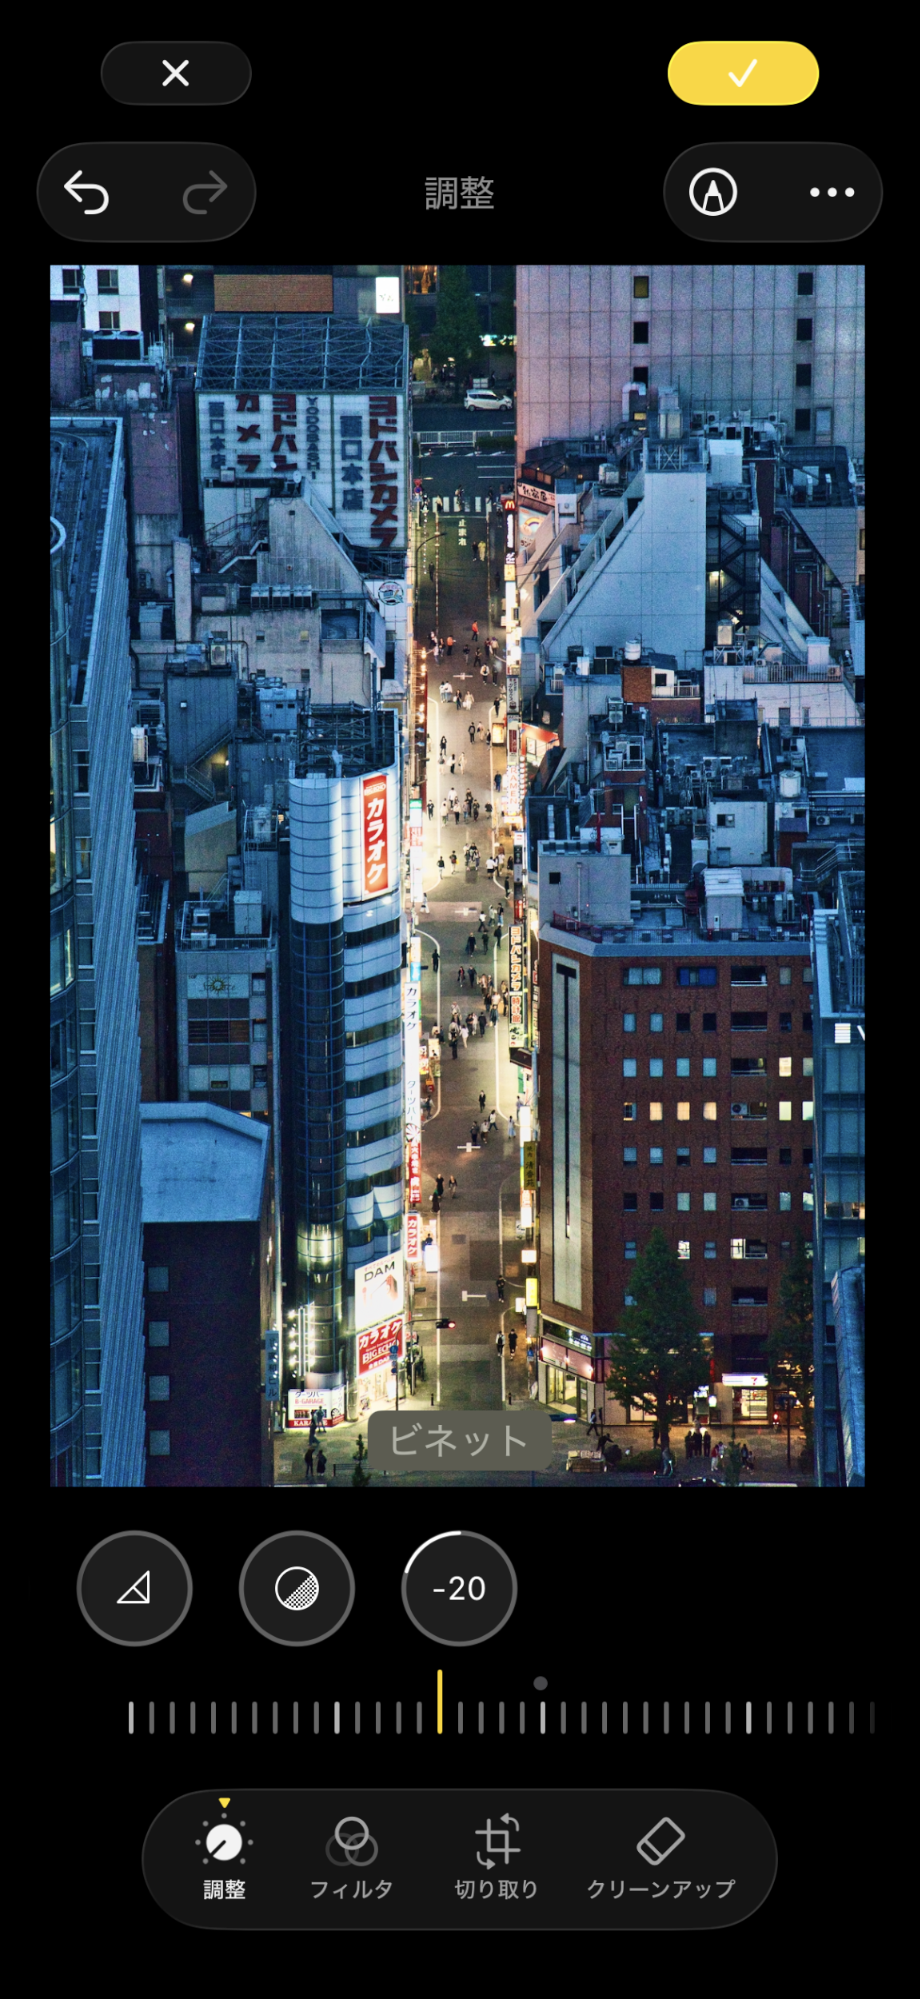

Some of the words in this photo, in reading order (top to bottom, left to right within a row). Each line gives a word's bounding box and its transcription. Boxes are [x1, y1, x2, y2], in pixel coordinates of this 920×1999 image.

[208, 401, 227, 470] 西口本店
[236, 394, 261, 472] カメラ
[271, 394, 298, 471] ヨドバシ
[306, 396, 320, 480] YODOBASHI
[340, 416, 364, 510] 西口本店
[368, 396, 399, 548] ヨドバシカメラ
[458, 519, 467, 546] 止まれ
[510, 767, 518, 804] RAMEN
[366, 797, 387, 885] カラオケ
[510, 926, 521, 990] ヨドバシカメラ
[406, 986, 418, 1031] カラオケ
[407, 1219, 417, 1255] カラオケ
[364, 1260, 395, 1282] DAM
[359, 1321, 402, 1350] カラオケ
[362, 1349, 377, 1364] BIG
[378, 1339, 400, 1354] ECHO
